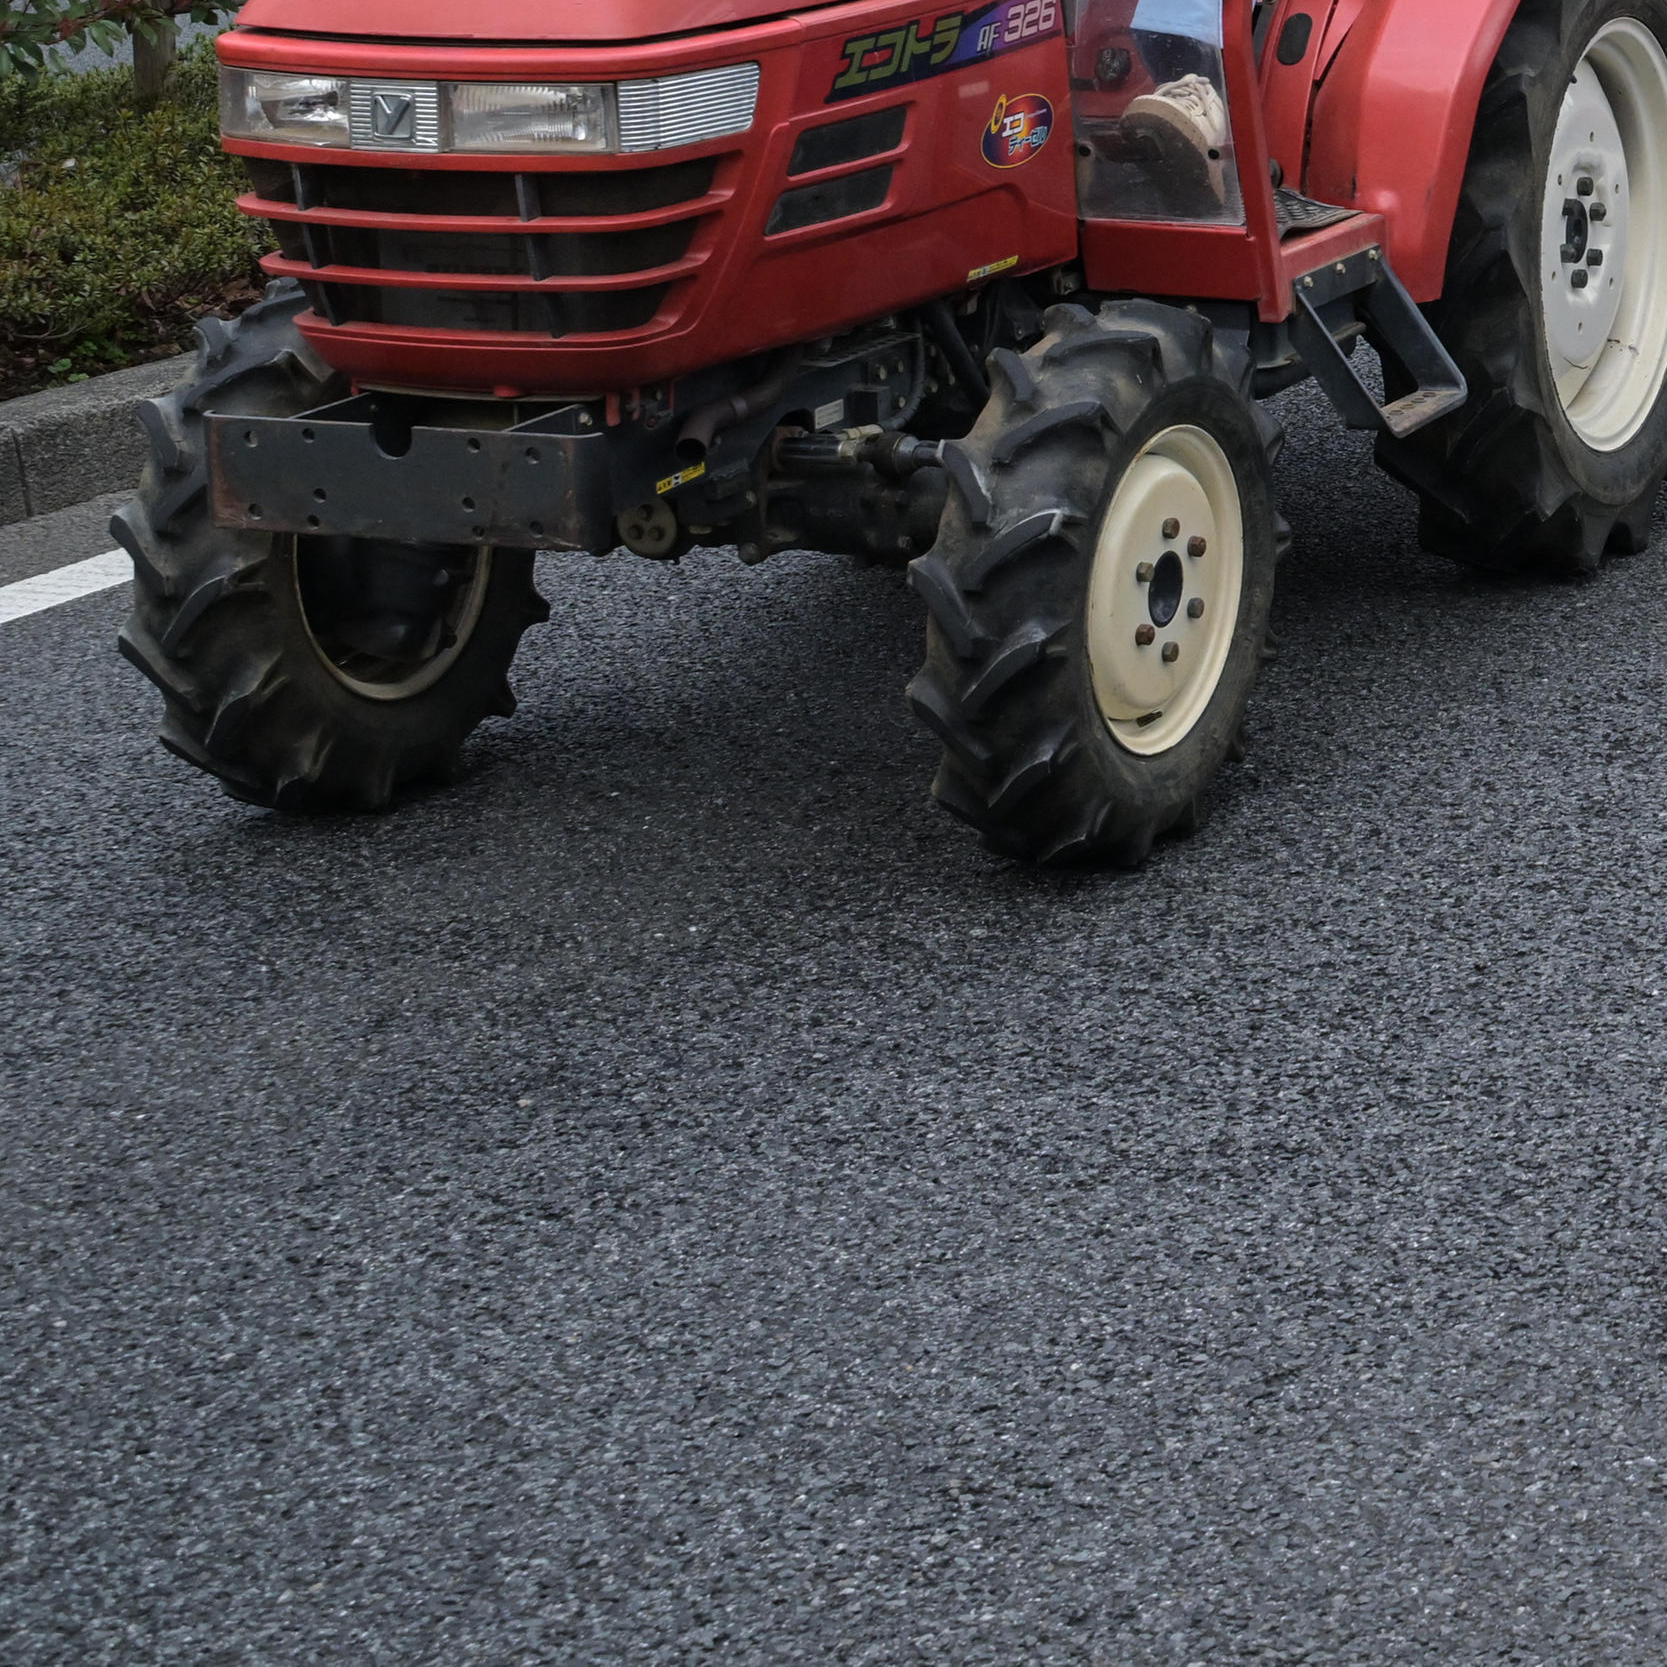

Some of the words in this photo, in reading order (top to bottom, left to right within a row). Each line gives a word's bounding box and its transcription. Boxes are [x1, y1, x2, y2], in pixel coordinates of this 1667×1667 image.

[834, 14, 964, 90] エコトラ
[976, 21, 1001, 53] AF
